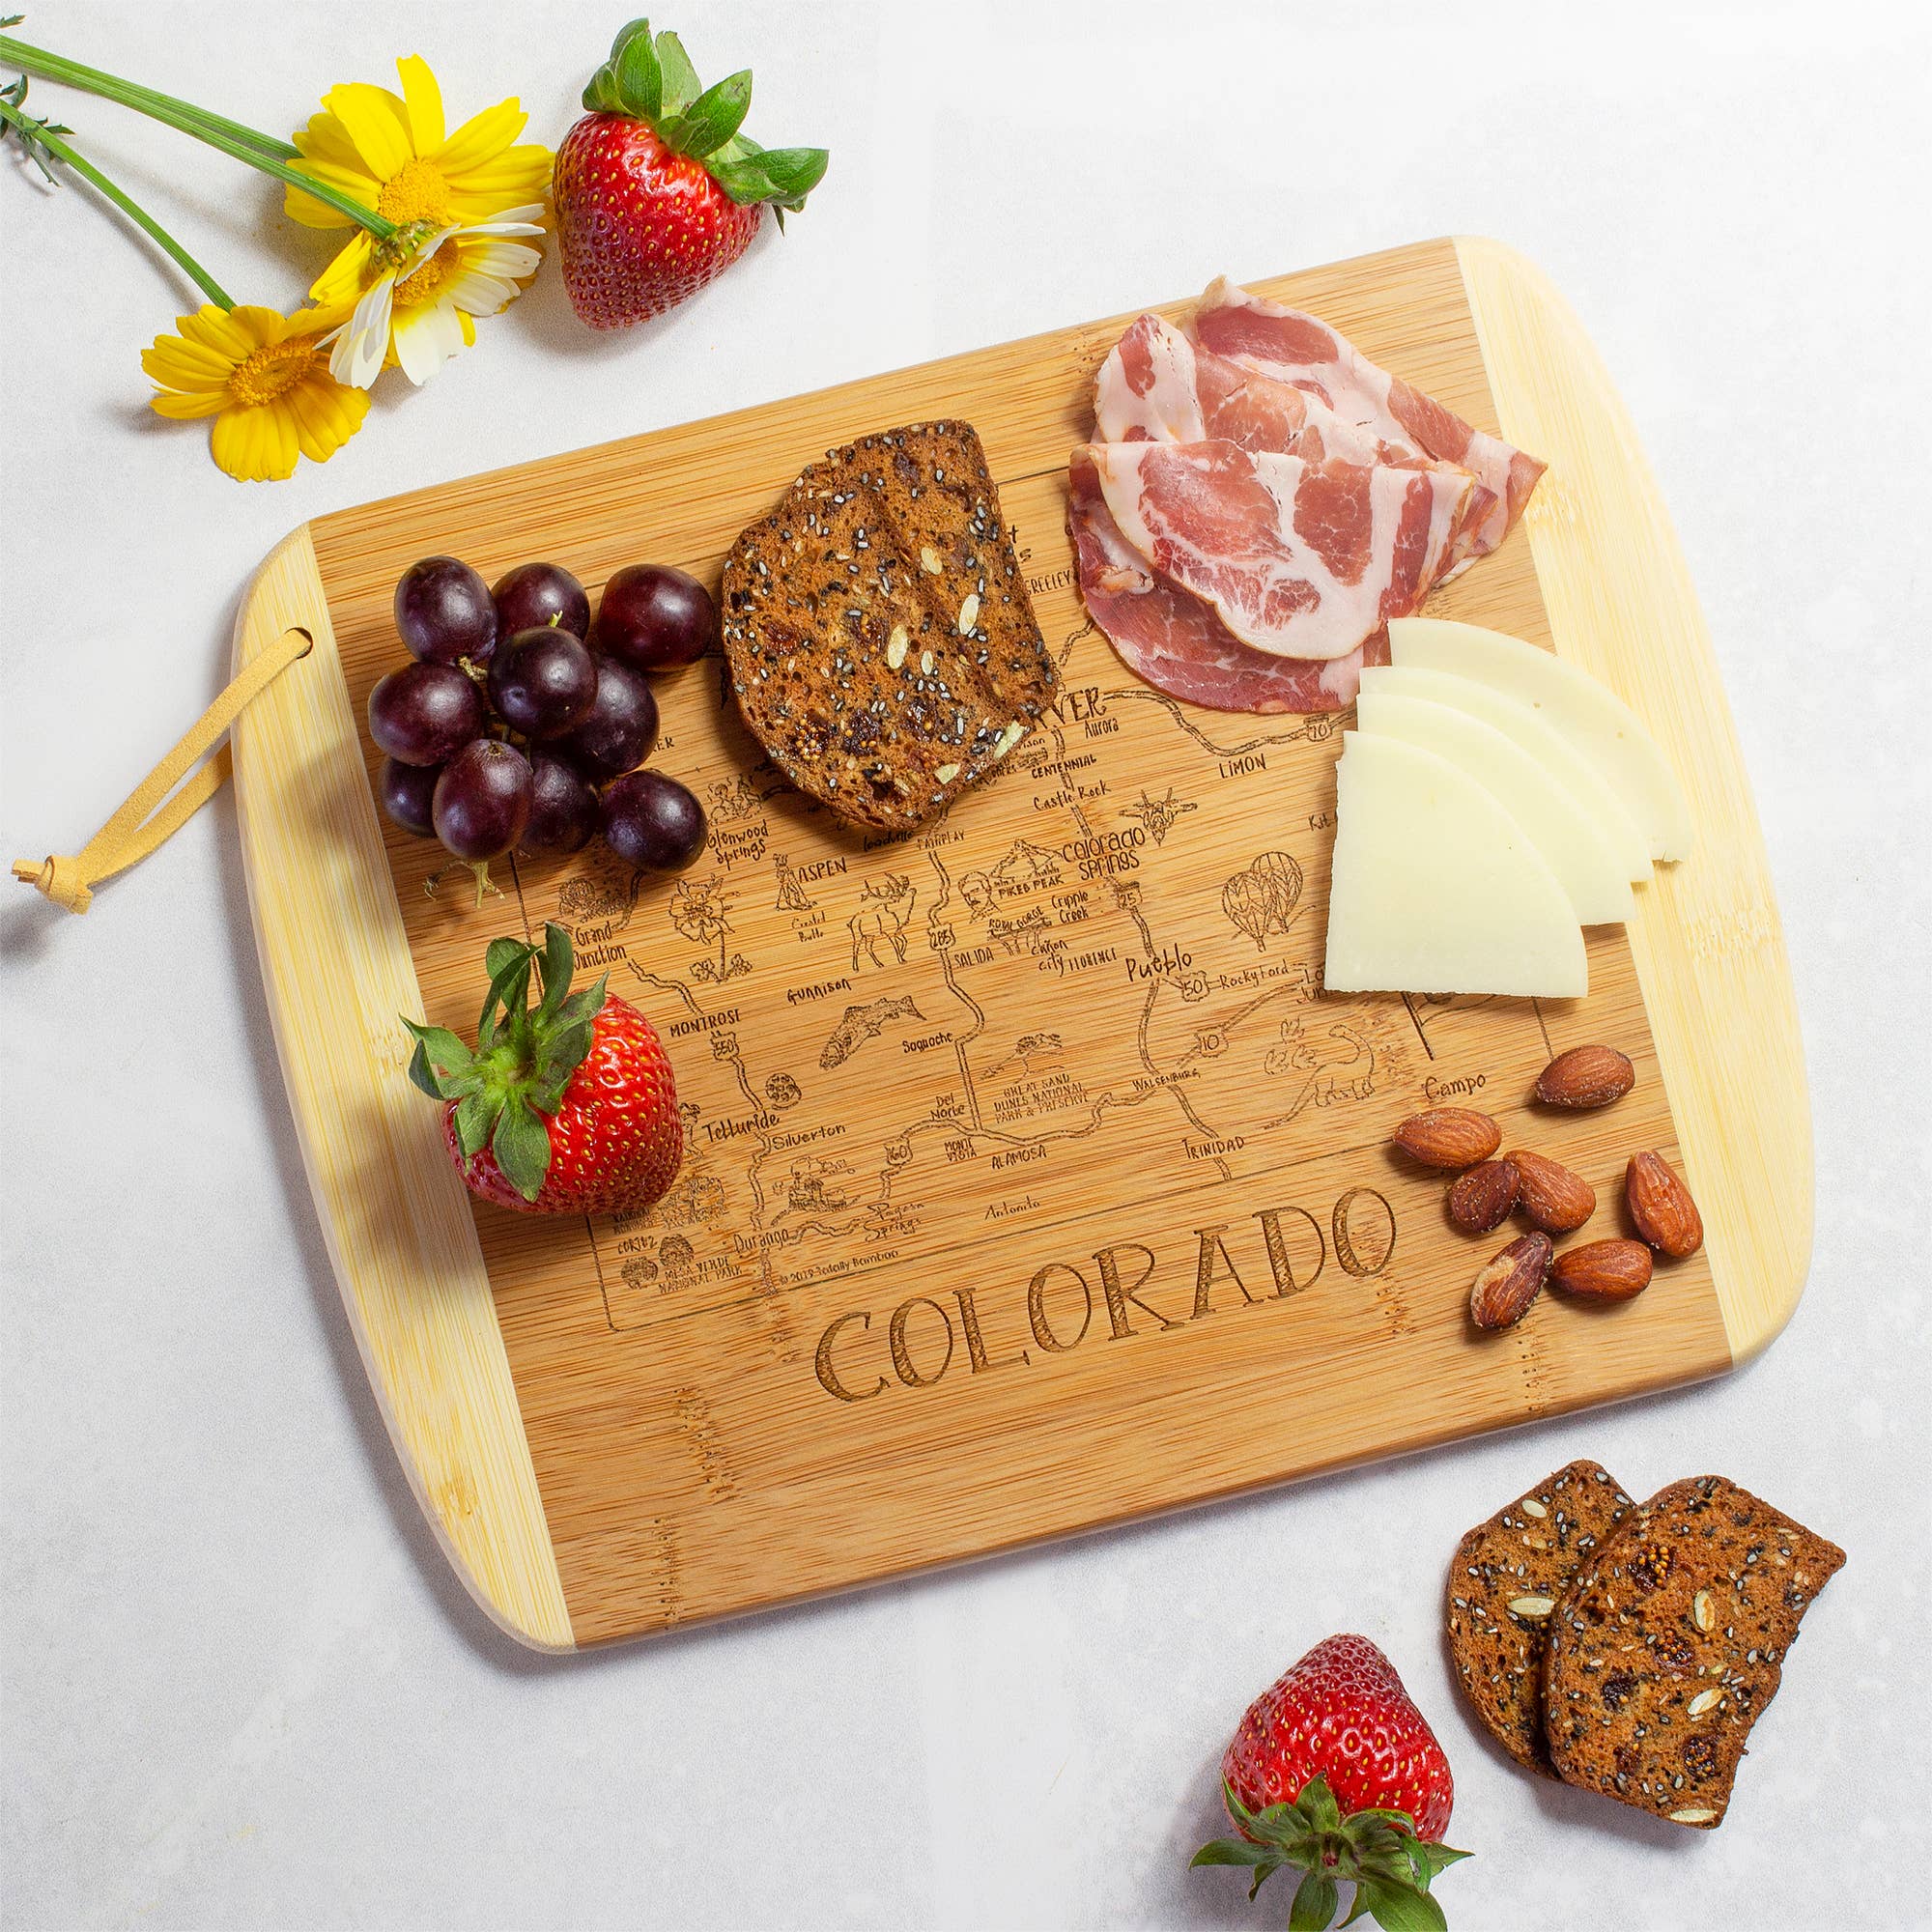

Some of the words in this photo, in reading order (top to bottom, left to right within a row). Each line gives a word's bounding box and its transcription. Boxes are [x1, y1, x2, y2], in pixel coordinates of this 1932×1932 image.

[1084, 718, 1119, 739] Aurora
[1031, 753, 1097, 779] CENTENNIAL
[1034, 790, 1075, 811] Castle
[1077, 780, 1112, 800] Rock
[706, 818, 769, 849] Glenwood
[798, 857, 848, 883] ASPEN
[1033, 874, 1065, 890] PEAK
[1051, 890, 1089, 909] Cripple
[1059, 905, 1089, 923] Creek
[575, 921, 611, 947] Grand
[929, 929, 952, 947] 285
[573, 944, 627, 971] Junction
[953, 947, 995, 968] SALIDA
[1124, 942, 1193, 982] Pueblo
[1183, 980, 1204, 996] 50
[1219, 969, 1259, 990] Rocky
[786, 979, 852, 1006] Gunnison
[1296, 985, 1327, 1005] Jun
[669, 1009, 741, 1037] MONTROSE
[714, 1038, 734, 1056] 550
[1202, 1035, 1220, 1050] 10
[994, 1095, 1029, 1112] DUNES
[1032, 1081, 1084, 1102] NATIONAL
[1004, 1081, 1037, 1097] GREAT
[1042, 1072, 1070, 1089] SAND
[1425, 1074, 1487, 1100] Campo
[936, 1093, 955, 1107] Del
[994, 1108, 1023, 1124] PARK
[1037, 1091, 1090, 1114] PRESERVE
[930, 1104, 965, 1122] Norte
[701, 1110, 781, 1143] Telluride
[772, 1123, 846, 1151] Silverton
[991, 1144, 1048, 1170] ALAMOSA
[1181, 1135, 1245, 1159] TRINIDAD
[733, 1228, 790, 1255] Durango
[696, 1255, 730, 1273] VERDE
[715, 1264, 743, 1281] PARK
[813, 1186, 1398, 1404] COLORADO
